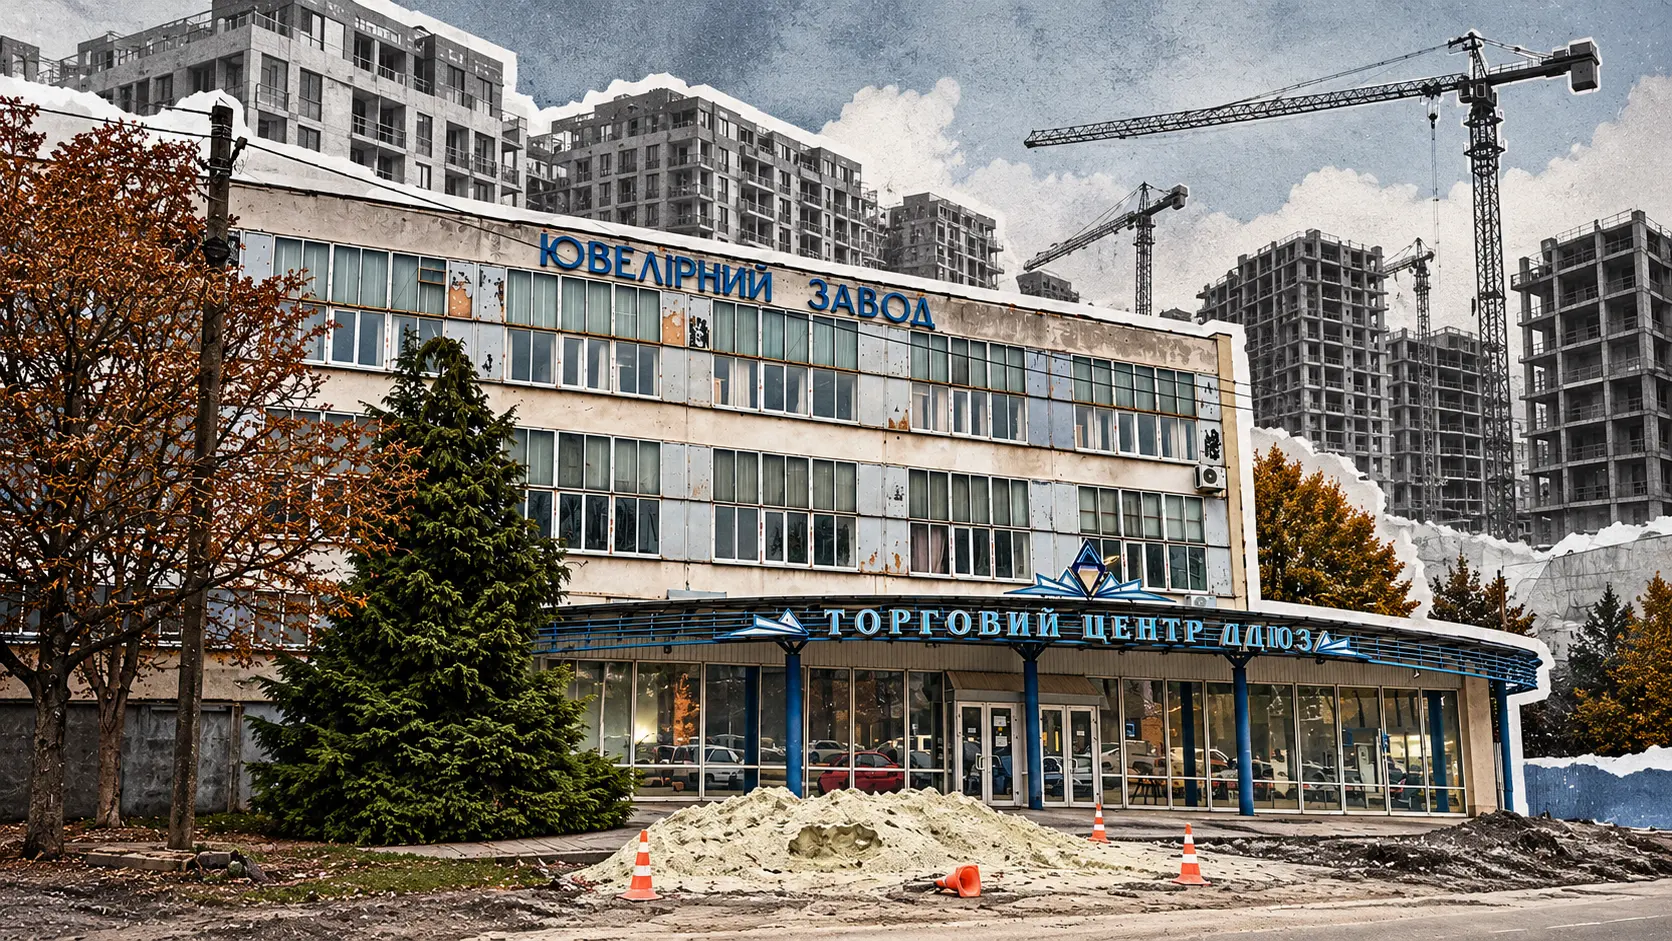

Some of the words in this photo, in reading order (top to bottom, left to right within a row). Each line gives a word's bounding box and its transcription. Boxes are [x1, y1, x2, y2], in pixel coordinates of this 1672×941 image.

[540, 232, 772, 302] ЮВЕЛІРНИЙ
[807, 278, 936, 330] ЗАВОД
[823, 607, 1060, 638] ТОРГОВИЙ
[1081, 614, 1204, 644] ЦЕНТР
